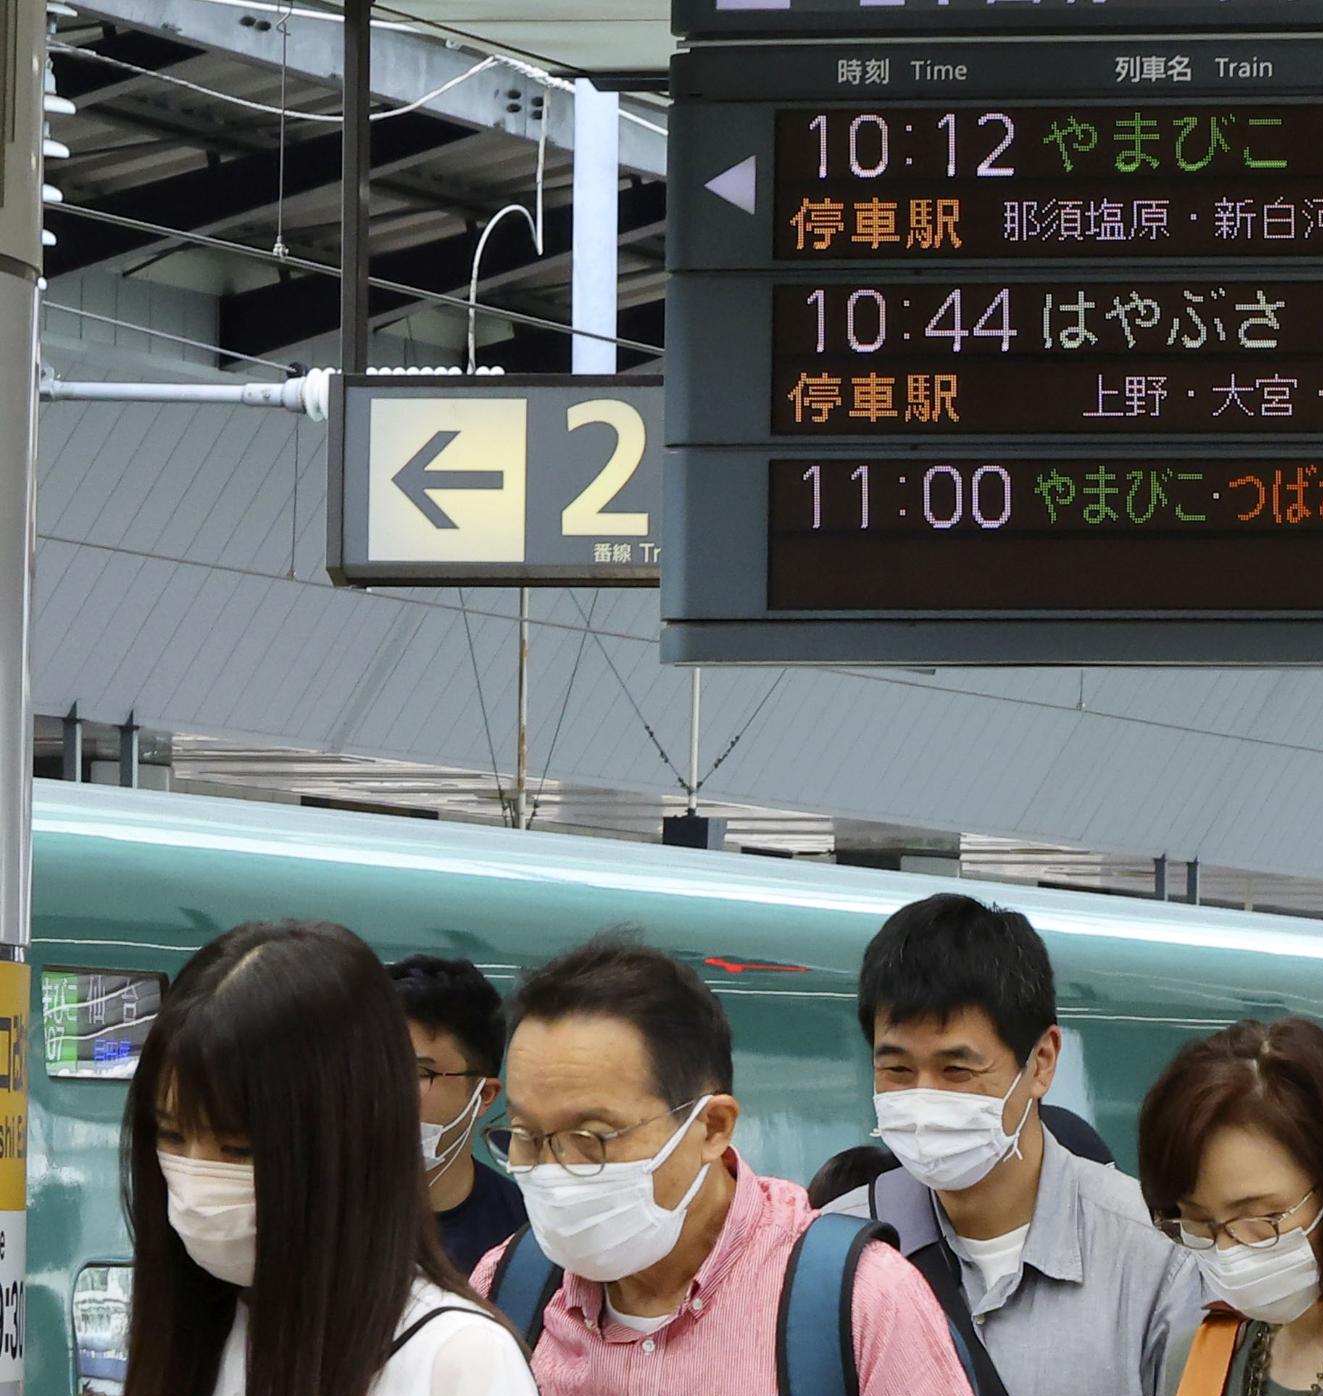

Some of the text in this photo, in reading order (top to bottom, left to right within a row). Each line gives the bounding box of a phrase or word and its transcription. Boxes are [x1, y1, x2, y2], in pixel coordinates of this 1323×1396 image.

[837, 58, 890, 85] 時刻
[910, 59, 968, 81] Time
[1115, 55, 1192, 83] 列車名
[1214, 56, 1273, 78] Train
[809, 112, 1015, 179] 10:12
[1043, 111, 1288, 173] やまびこ
[789, 197, 963, 250] 停車駅
[807, 288, 1018, 353] 10:44
[1043, 287, 1286, 349] はやぶさ
[787, 371, 960, 423] 停車駅
[561, 399, 647, 536] 2
[803, 465, 1011, 529] 11:00
[593, 542, 661, 563] 番線 Tr
